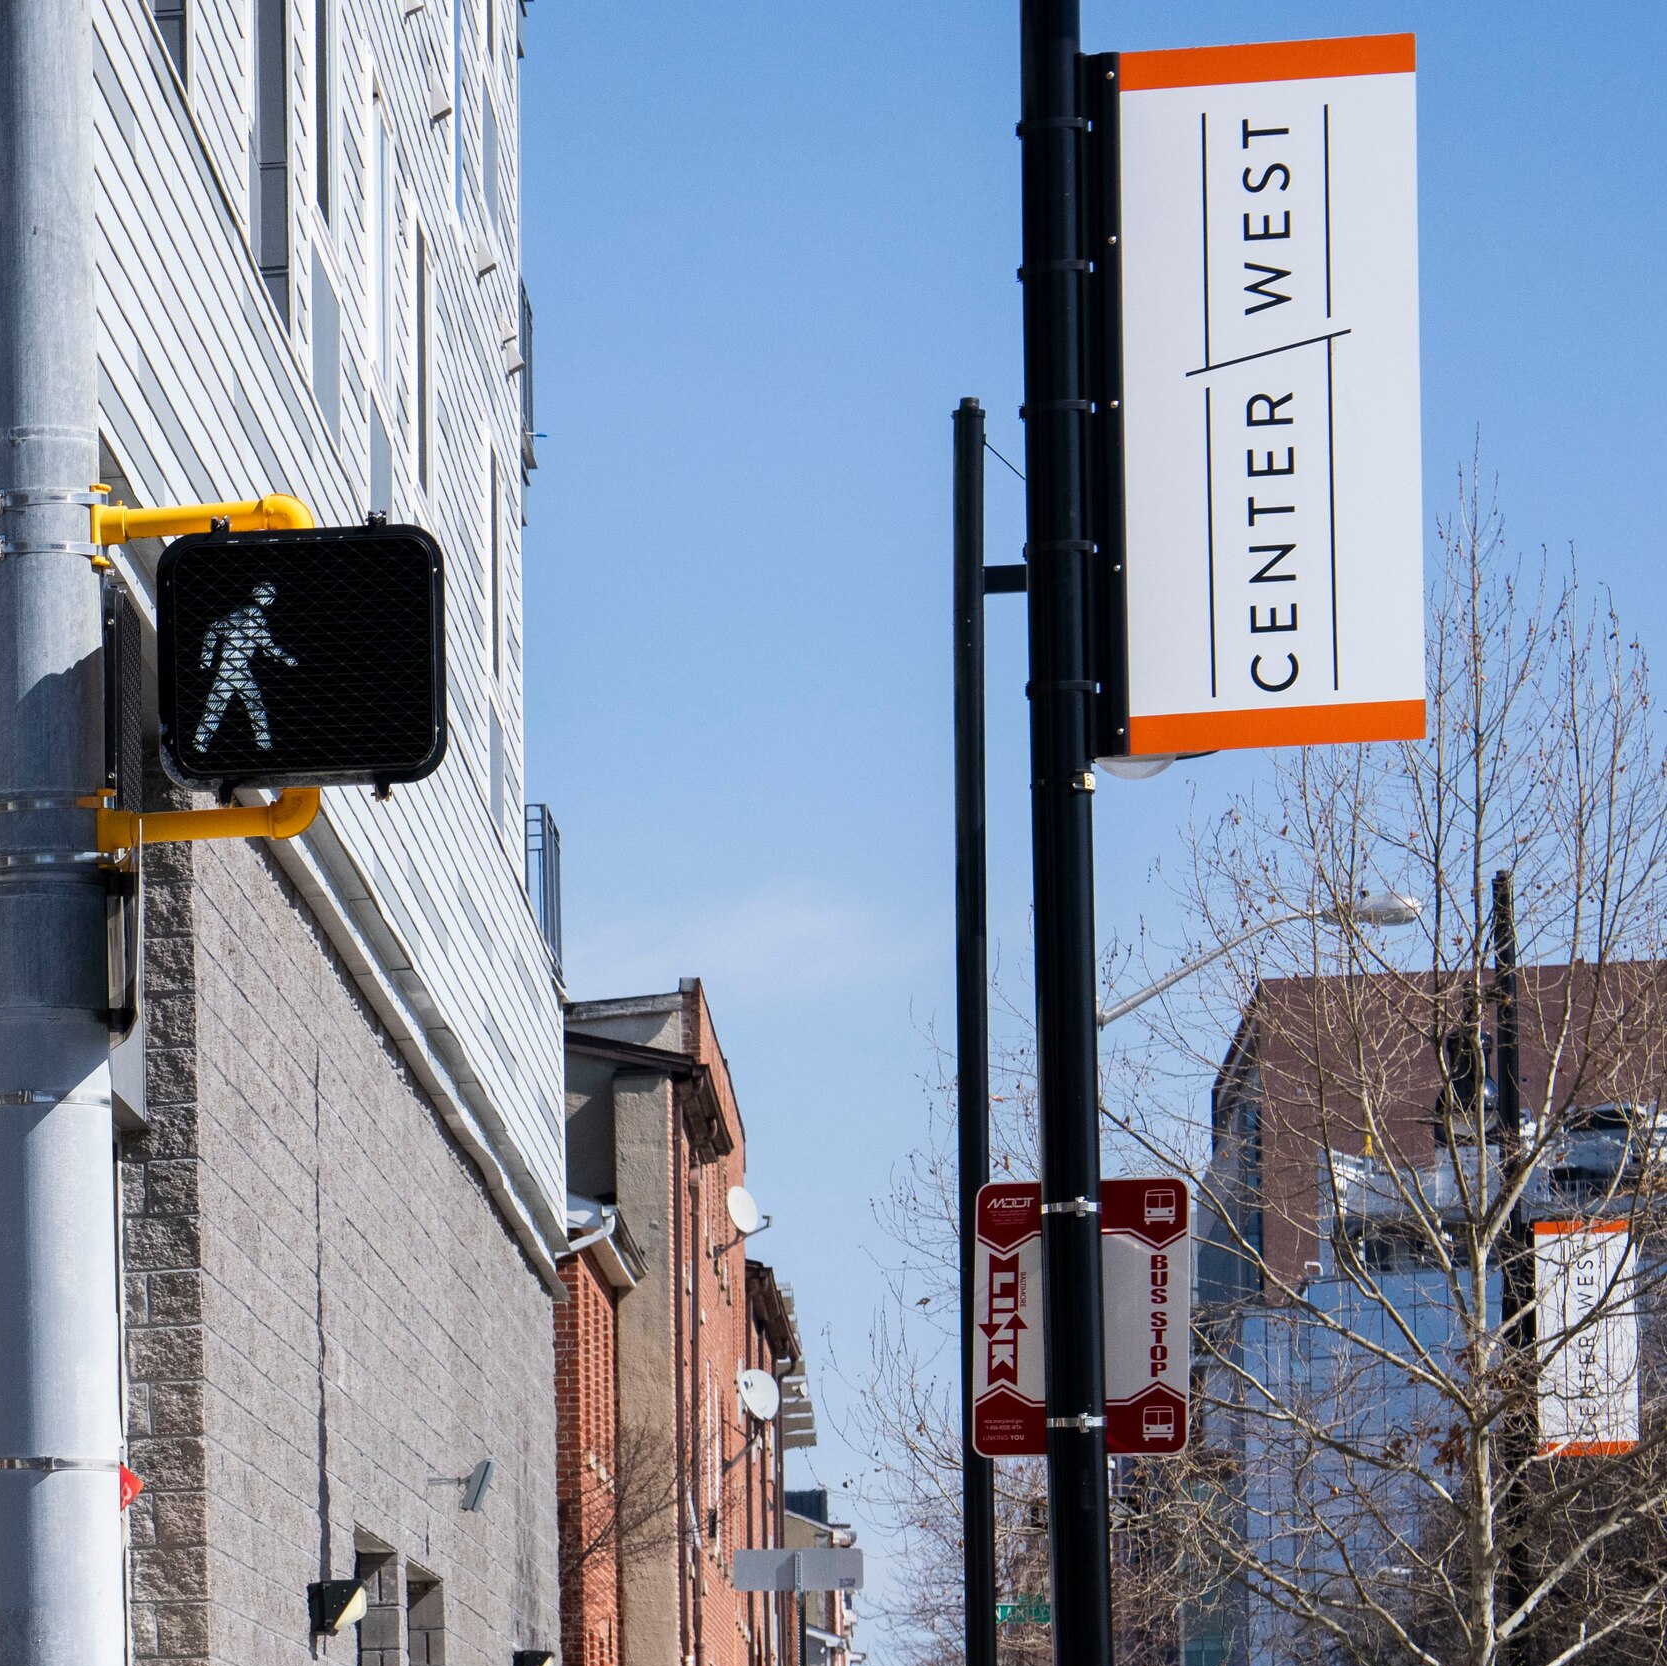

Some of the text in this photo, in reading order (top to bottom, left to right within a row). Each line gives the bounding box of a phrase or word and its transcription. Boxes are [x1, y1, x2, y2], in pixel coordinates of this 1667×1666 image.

[1242, 117, 1299, 693] CENTER WEST
[1150, 1254, 1168, 1378] BUS STOP
